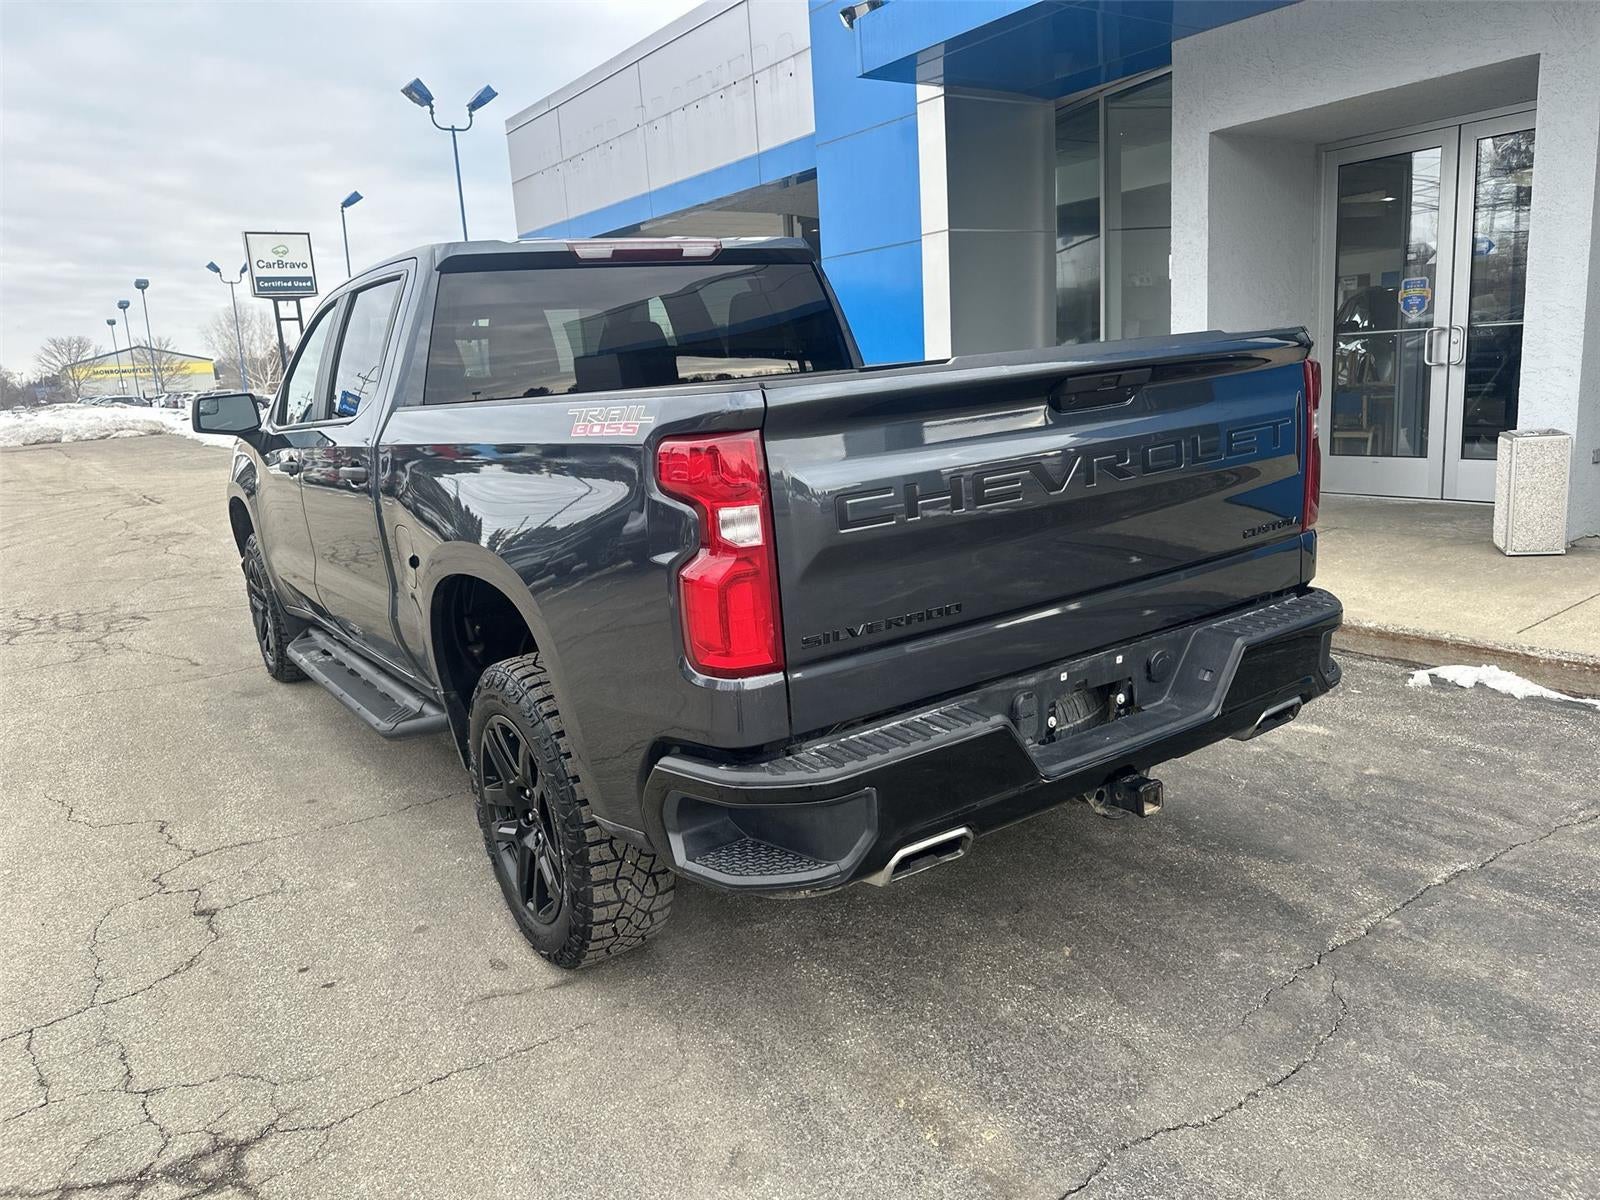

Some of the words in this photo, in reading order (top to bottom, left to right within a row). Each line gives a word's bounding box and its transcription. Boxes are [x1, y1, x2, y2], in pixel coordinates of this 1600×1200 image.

[256, 259, 308, 269] CarBravo
[568, 405, 655, 423] TRAIL
[571, 421, 640, 436] BOSS
[834, 419, 1292, 534] CHEVROLET
[801, 602, 962, 650] SILVERADO
